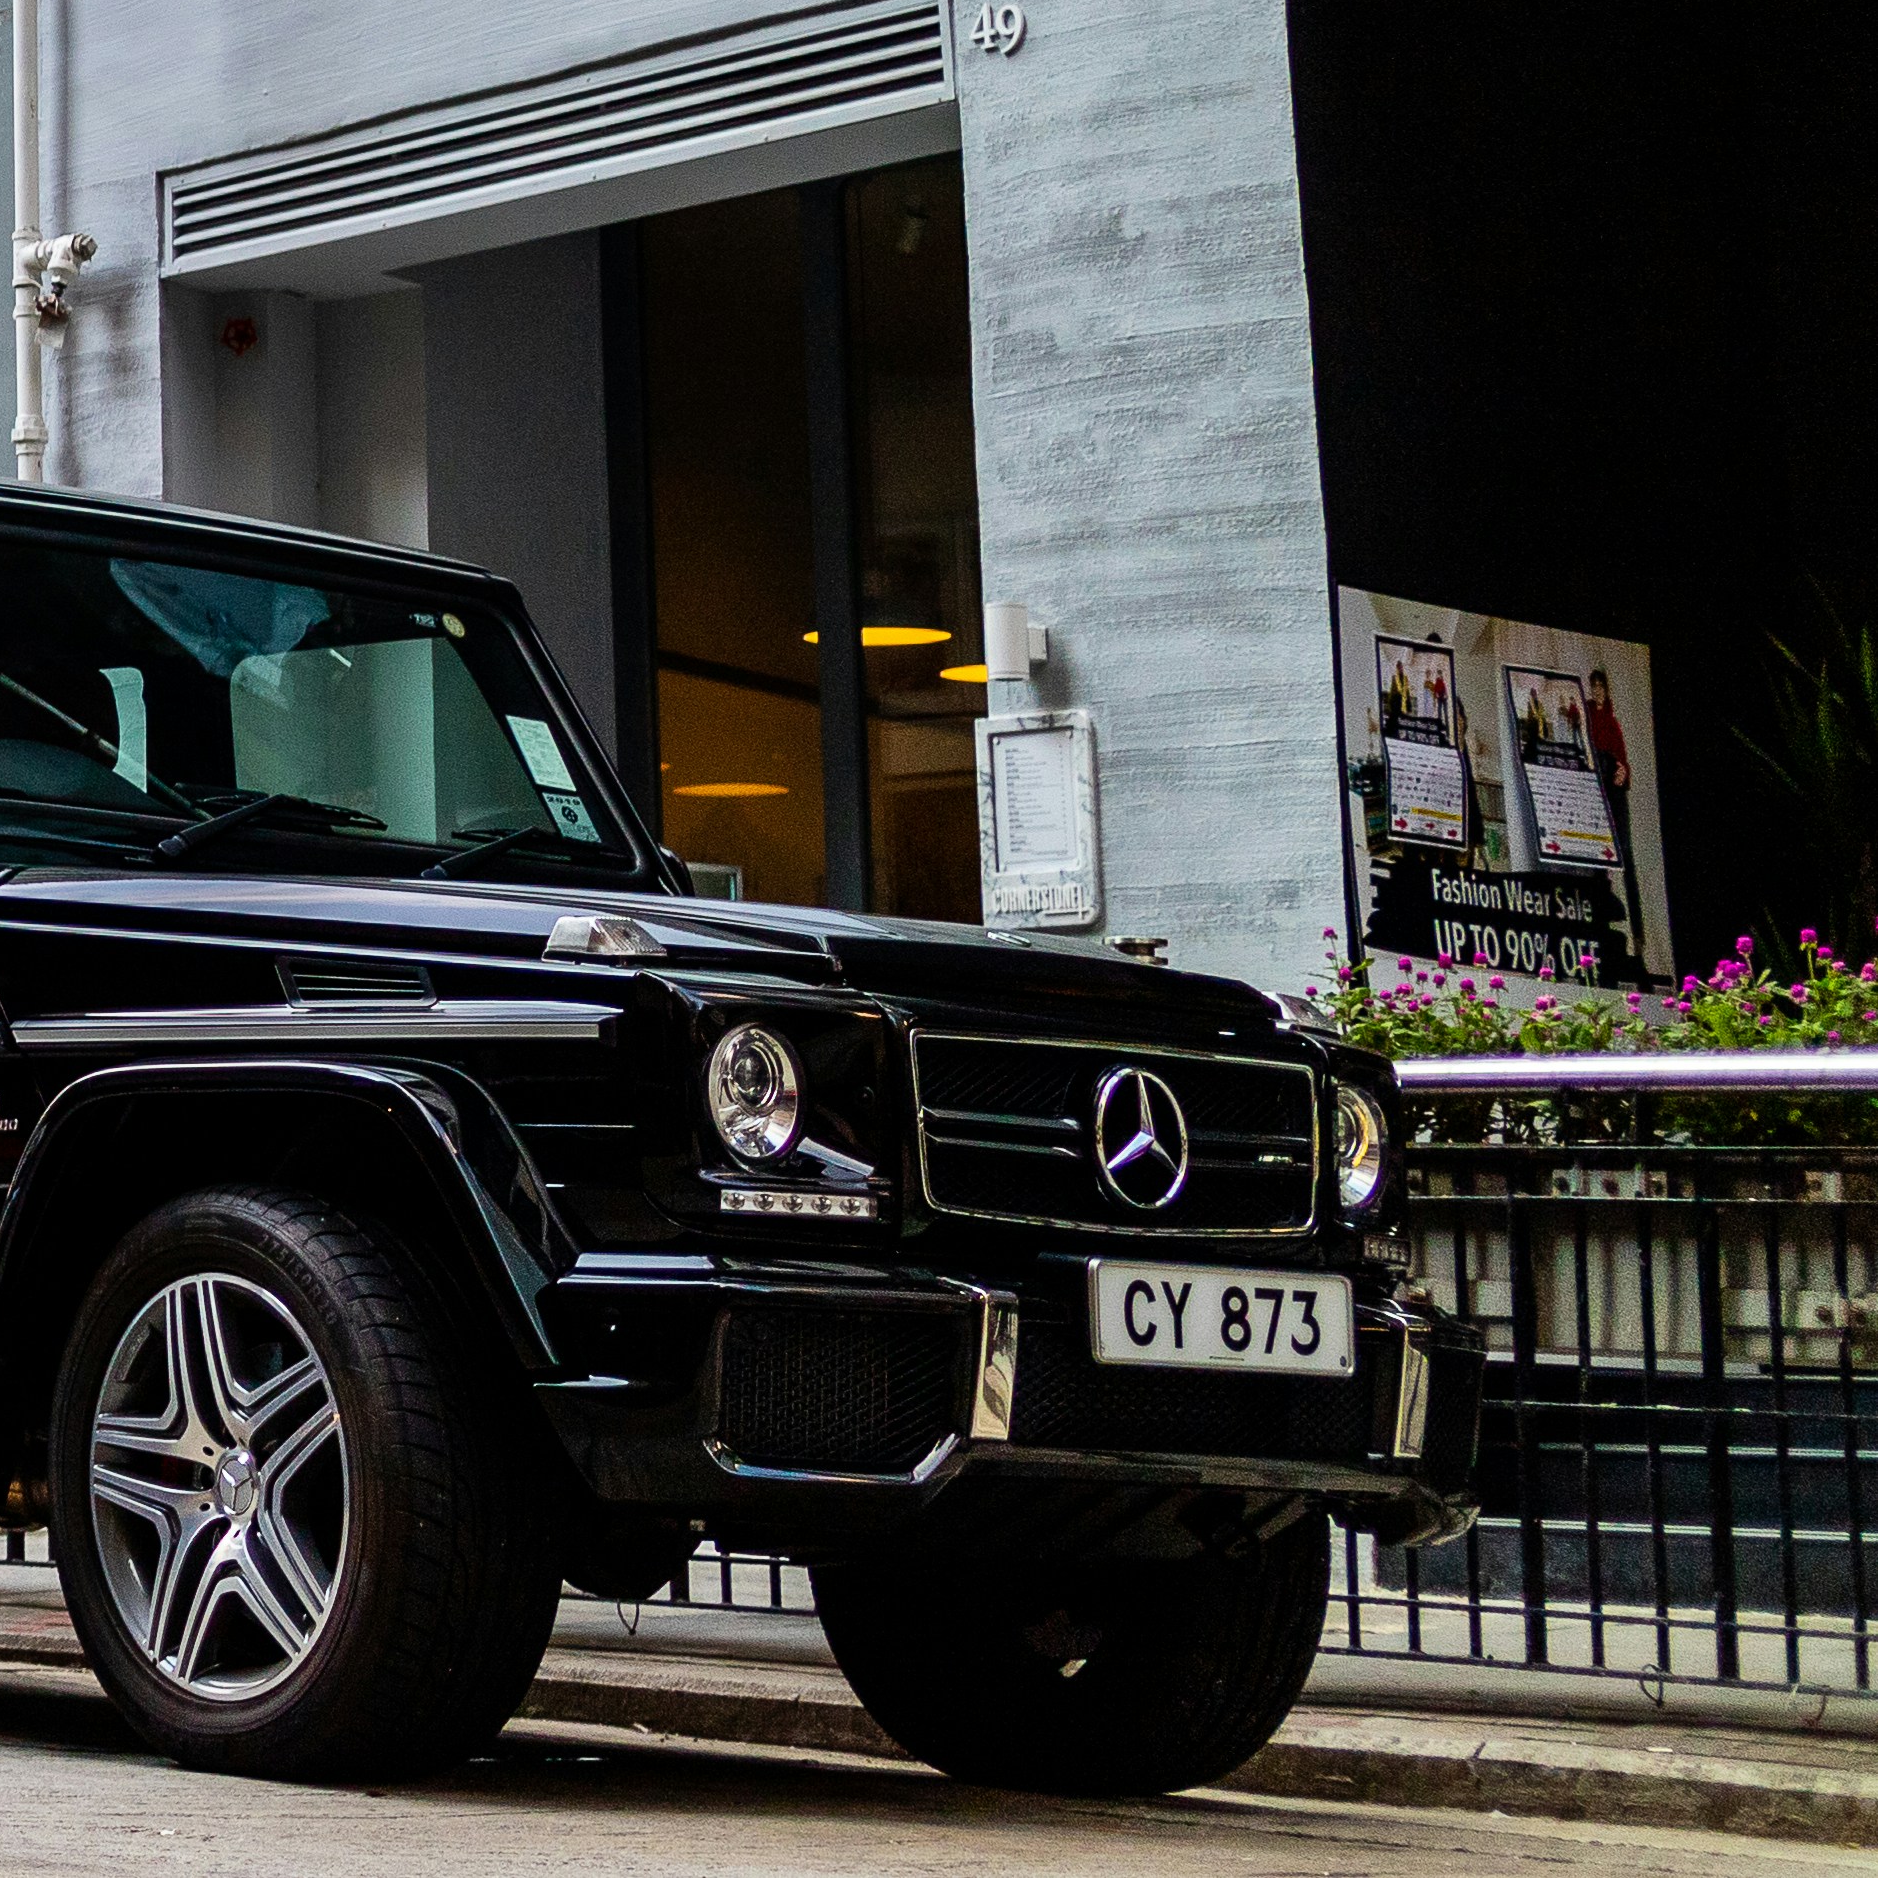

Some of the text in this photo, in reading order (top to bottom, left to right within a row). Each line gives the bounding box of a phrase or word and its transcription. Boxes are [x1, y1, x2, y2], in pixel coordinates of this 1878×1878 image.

[970, 2, 1025, 55] 49
[1431, 868, 1594, 923] Fashion Wear Sale
[1434, 919, 1601, 980] UP TO 90% OFF
[1123, 1279, 1322, 1356] CY 873
